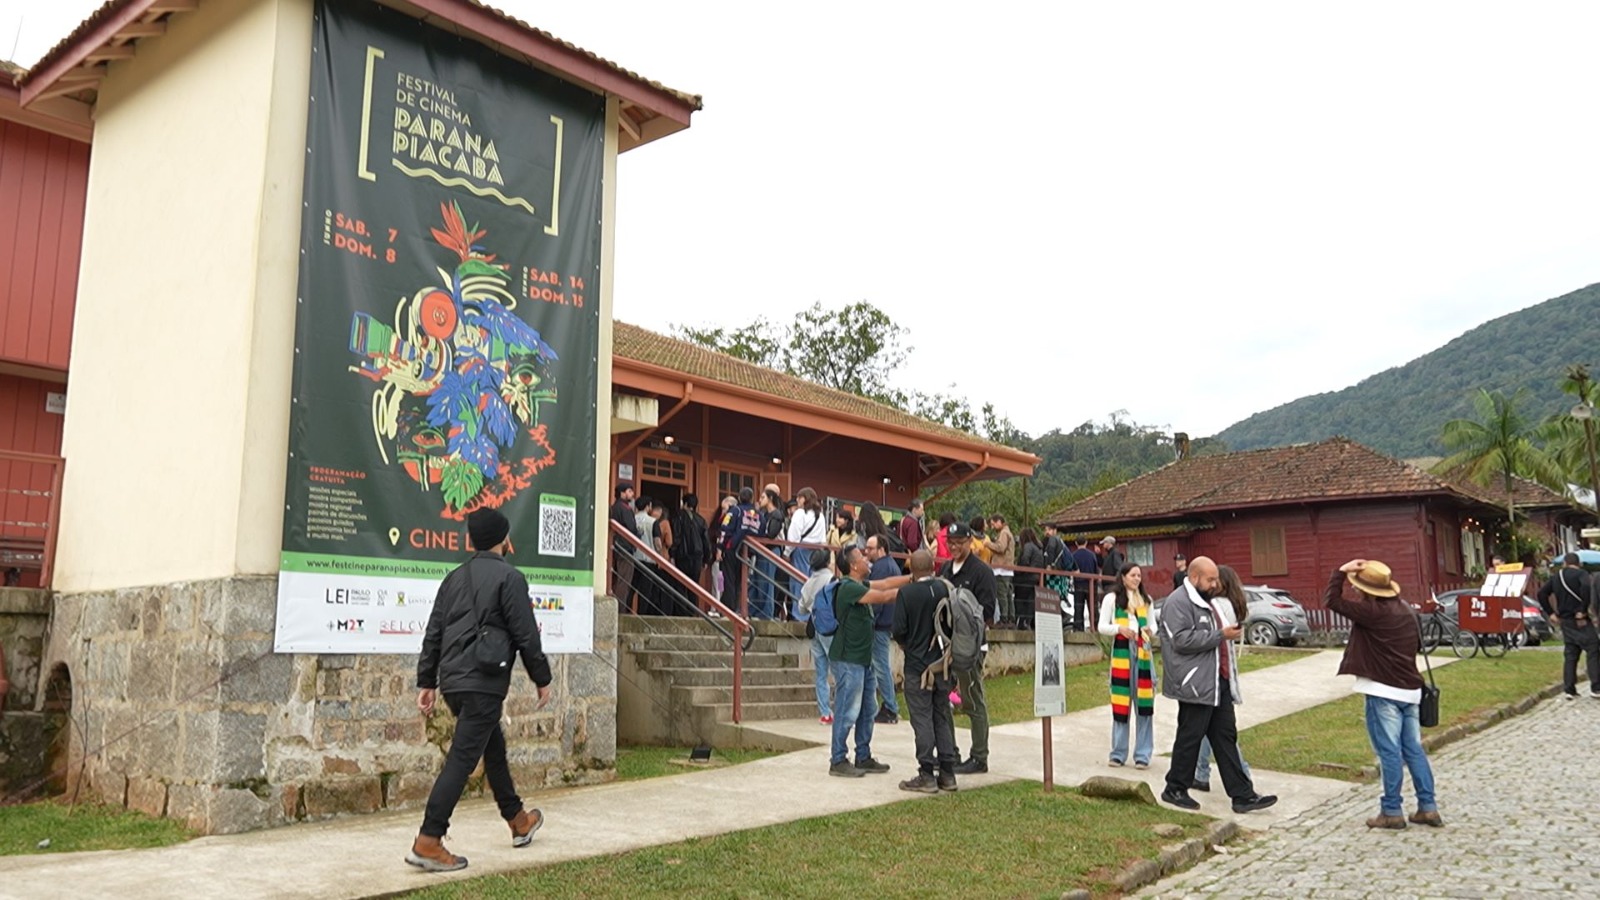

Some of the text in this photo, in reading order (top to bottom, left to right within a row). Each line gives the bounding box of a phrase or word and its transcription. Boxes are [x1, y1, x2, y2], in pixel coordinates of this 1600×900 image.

[397, 72, 458, 106] FESTIVAL
[396, 88, 471, 127] DE CINEMA
[394, 107, 500, 163] PARANA
[392, 130, 505, 186] PIACABA
[335, 212, 398, 243] SAB. 7
[334, 232, 397, 263] DOM. 8
[530, 267, 584, 290] SAB. 14
[529, 285, 584, 308] DOM. 15
[309, 466, 367, 479] PROGRAMAÇÃO
[309, 474, 346, 485] GRATUITA
[409, 528, 459, 551] CINE
[325, 588, 350, 605] LEI
